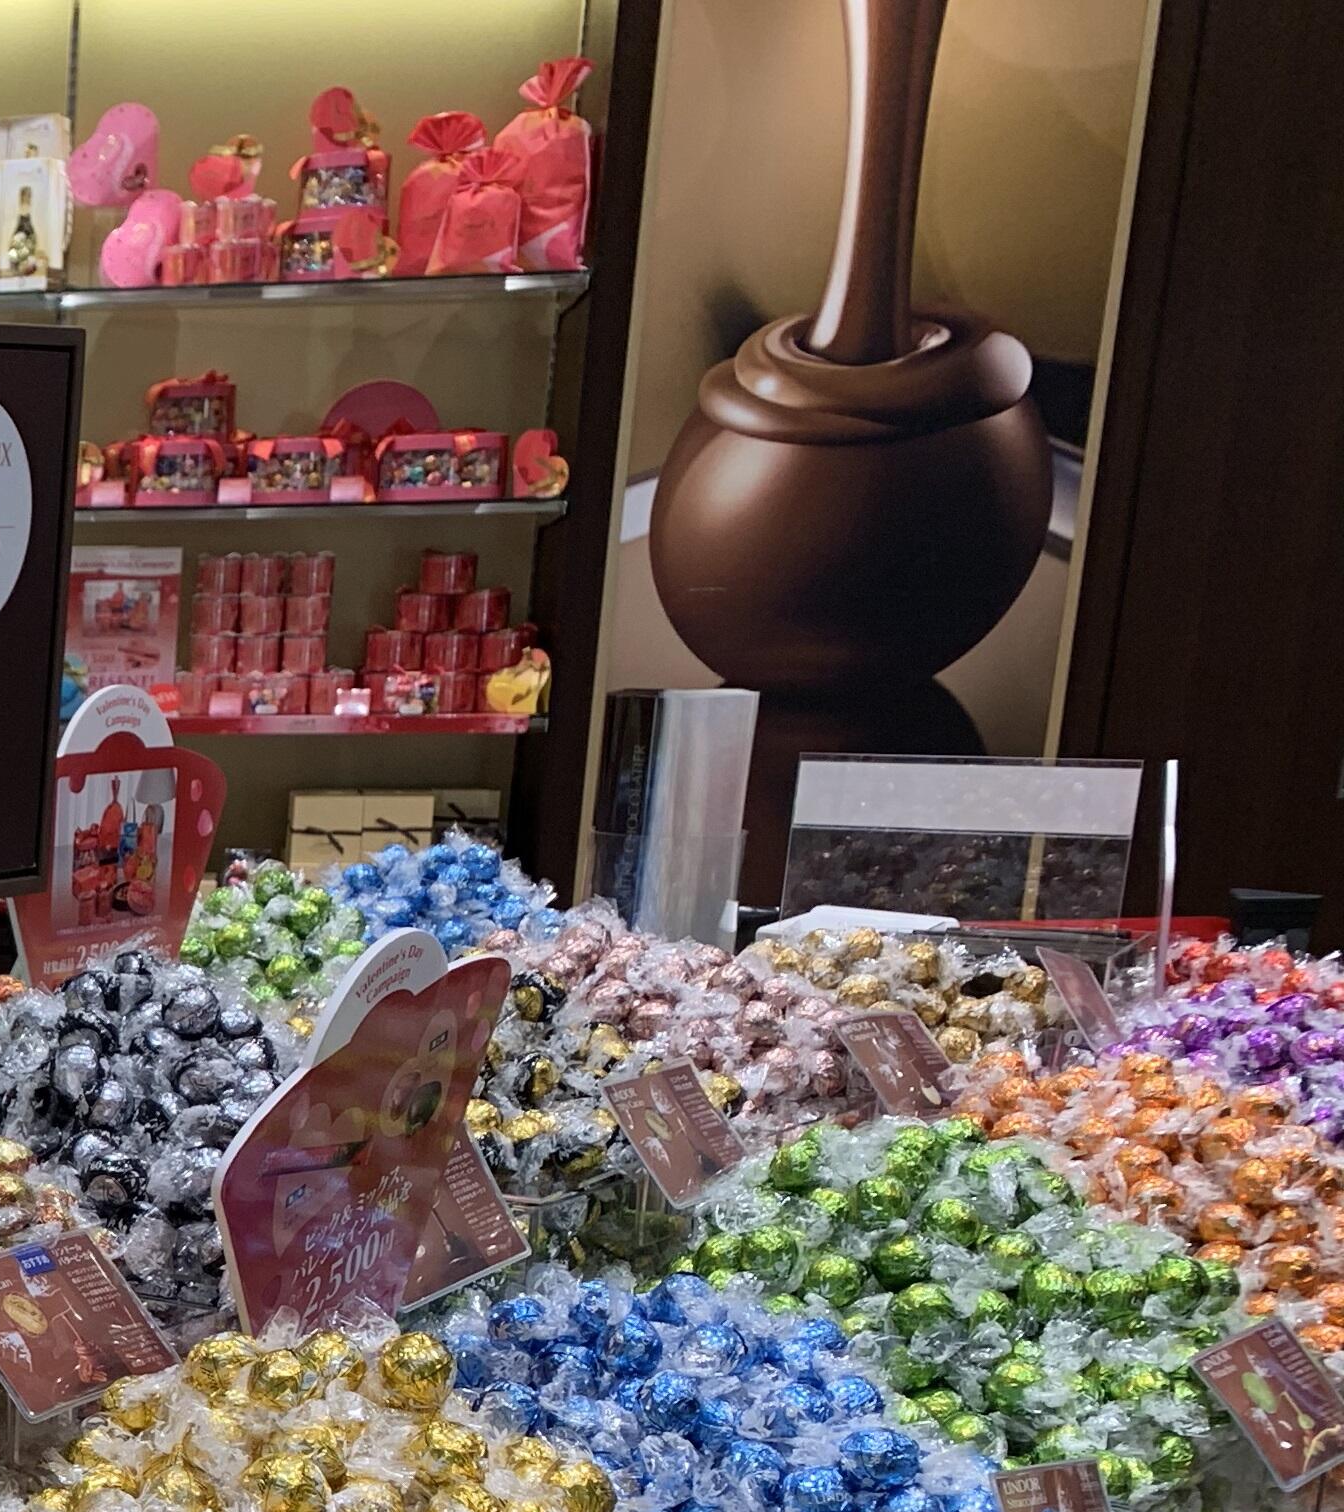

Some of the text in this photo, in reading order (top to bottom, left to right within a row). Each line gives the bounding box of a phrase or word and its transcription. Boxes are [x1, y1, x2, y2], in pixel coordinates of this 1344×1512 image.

[354, 944, 425, 999] Valentine's Day
[365, 967, 411, 1005] Campaign
